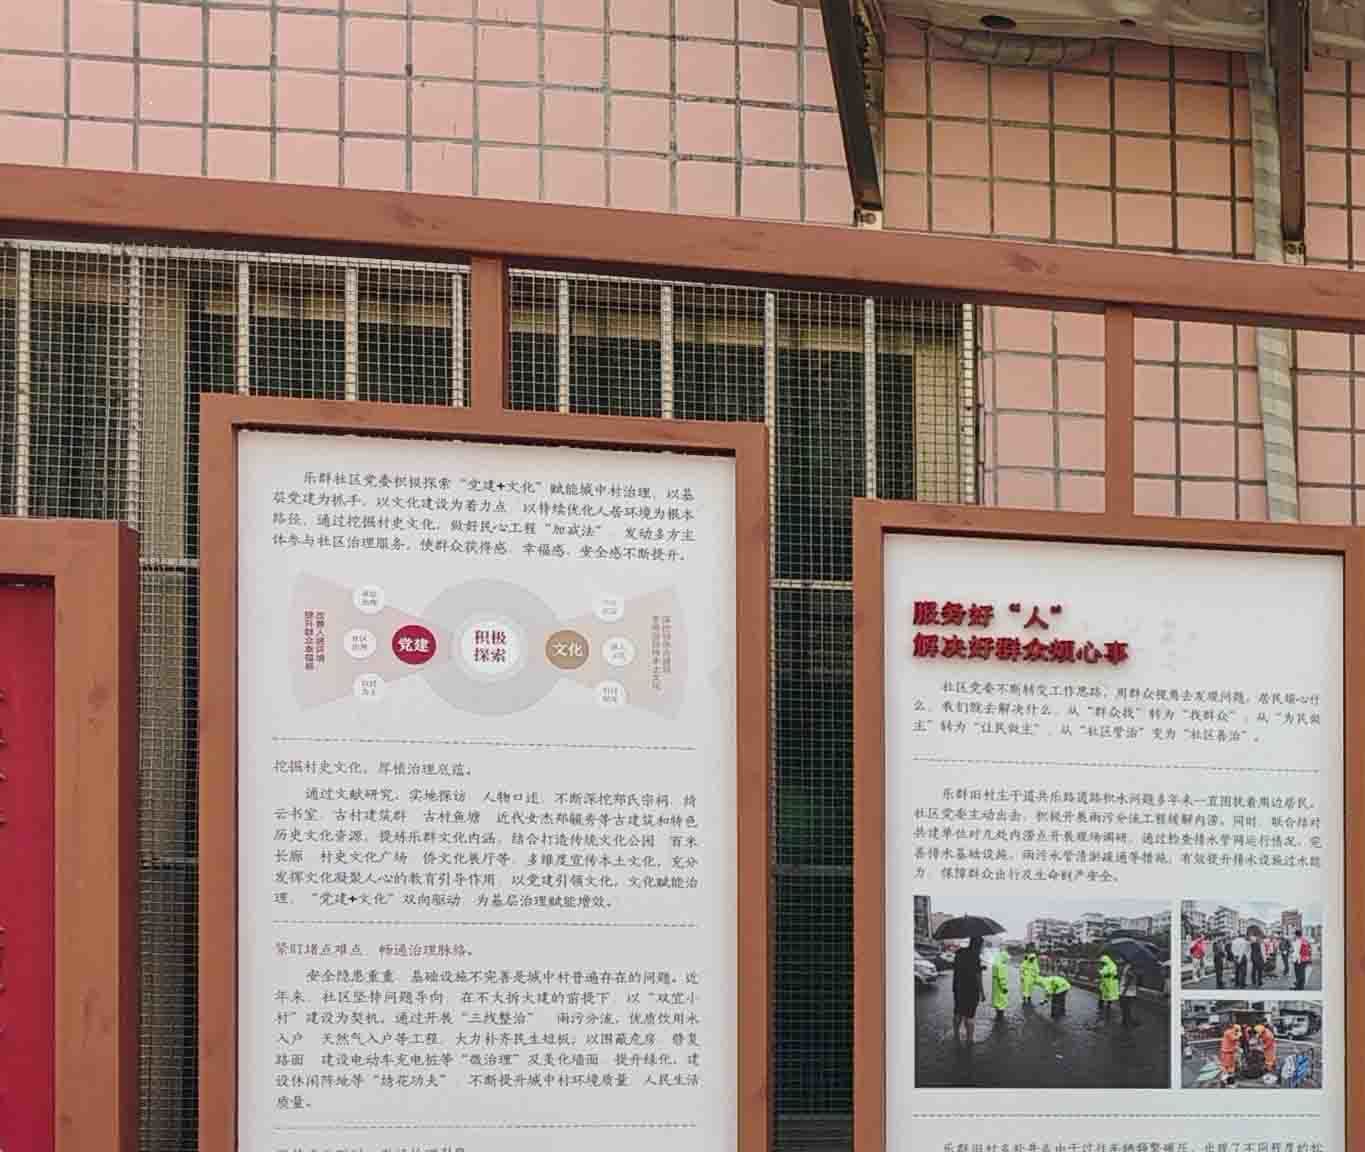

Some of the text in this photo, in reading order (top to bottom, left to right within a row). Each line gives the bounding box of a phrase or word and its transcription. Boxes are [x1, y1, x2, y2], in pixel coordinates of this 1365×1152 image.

[912, 600, 1063, 630] 服务好“人”
[398, 637, 431, 653] 党建
[474, 629, 507, 646] 积极
[474, 647, 507, 663] 探索
[551, 641, 584, 657] 文化
[912, 632, 1129, 666] 解决好群众烦心事
